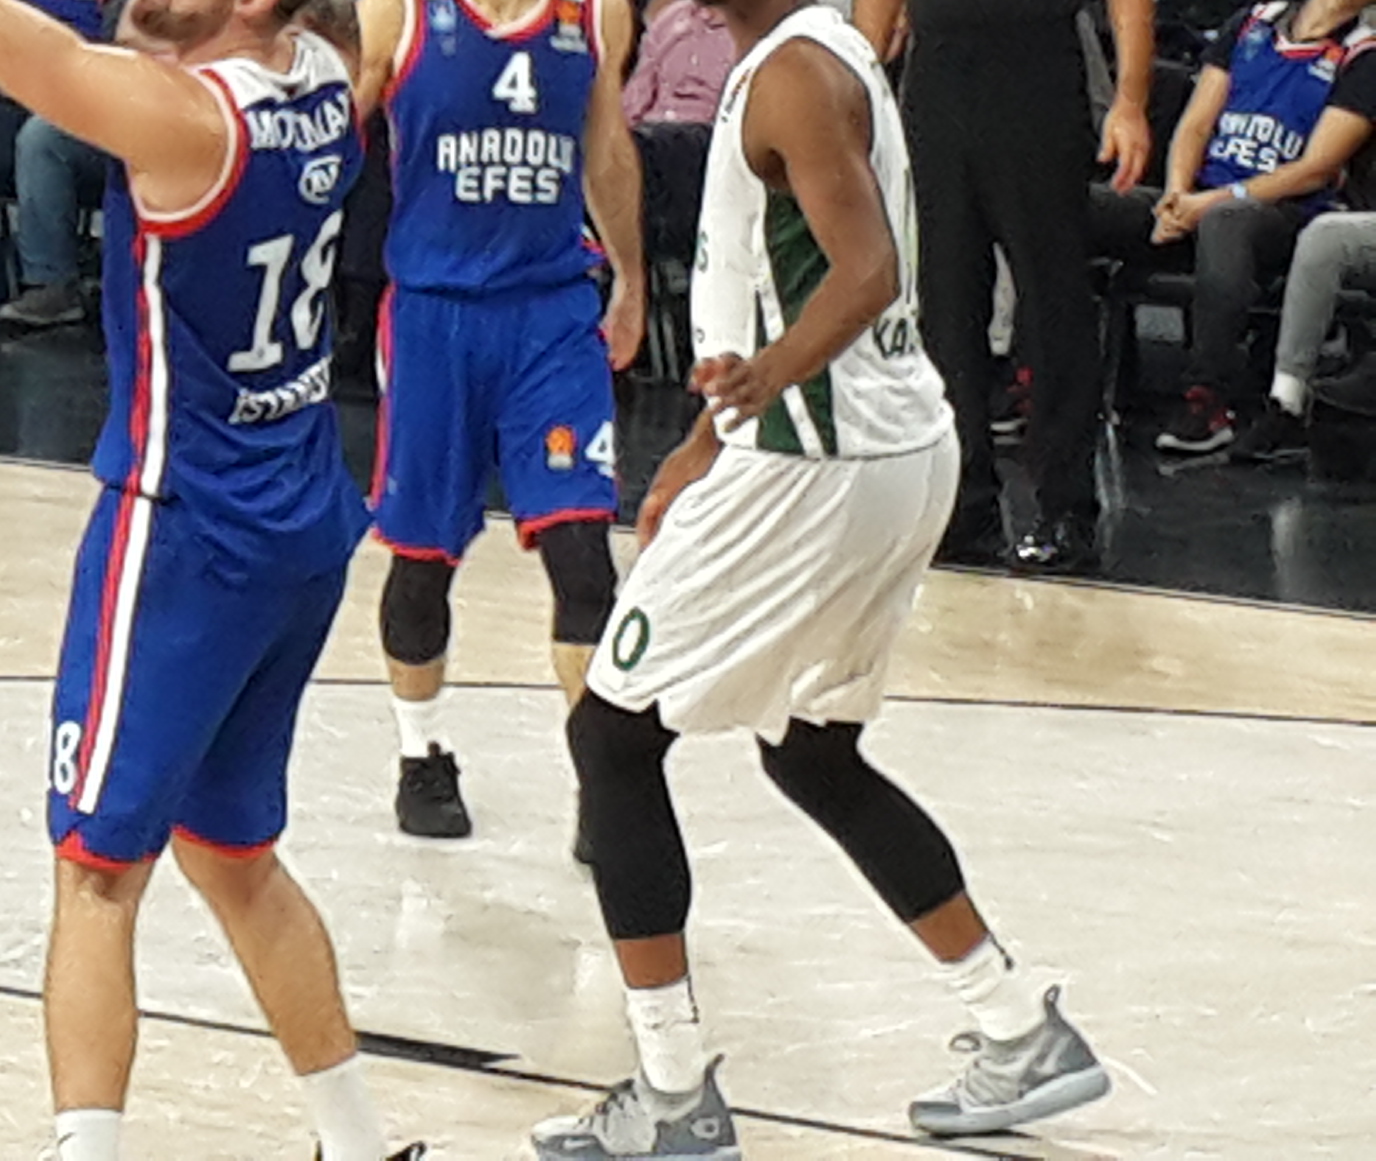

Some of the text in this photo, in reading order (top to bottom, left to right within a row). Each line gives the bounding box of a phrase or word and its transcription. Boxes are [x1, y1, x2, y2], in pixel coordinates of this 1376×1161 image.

[492, 51, 538, 114] 4
[437, 128, 576, 174] ANADOLU
[455, 166, 561, 205] EFES
[227, 208, 343, 372] 18
[584, 420, 617, 479] 4
